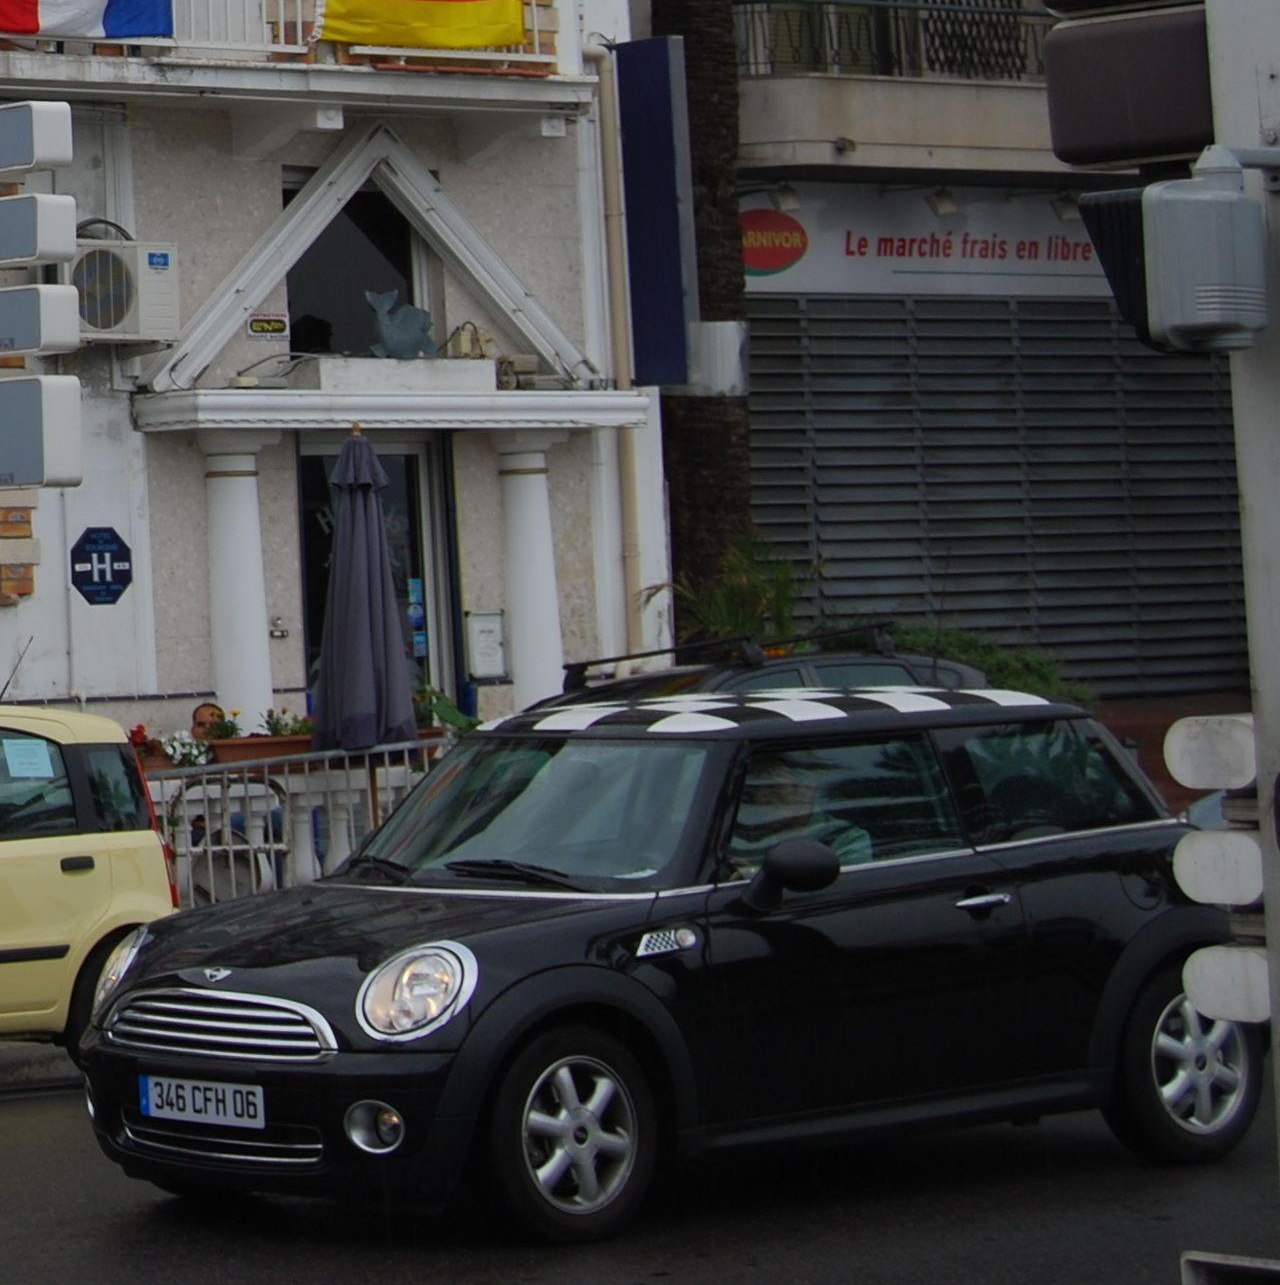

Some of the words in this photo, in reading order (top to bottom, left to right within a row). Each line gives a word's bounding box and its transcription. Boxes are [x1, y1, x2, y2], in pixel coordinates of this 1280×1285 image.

[844, 230, 868, 256] Le
[877, 231, 952, 258] marché
[962, 233, 1007, 260] frais
[1016, 239, 1038, 260] en
[92, 553, 112, 582] H
[154, 1081, 186, 1112] 346
[191, 1085, 227, 1116] CFH
[233, 1089, 258, 1119] 06
